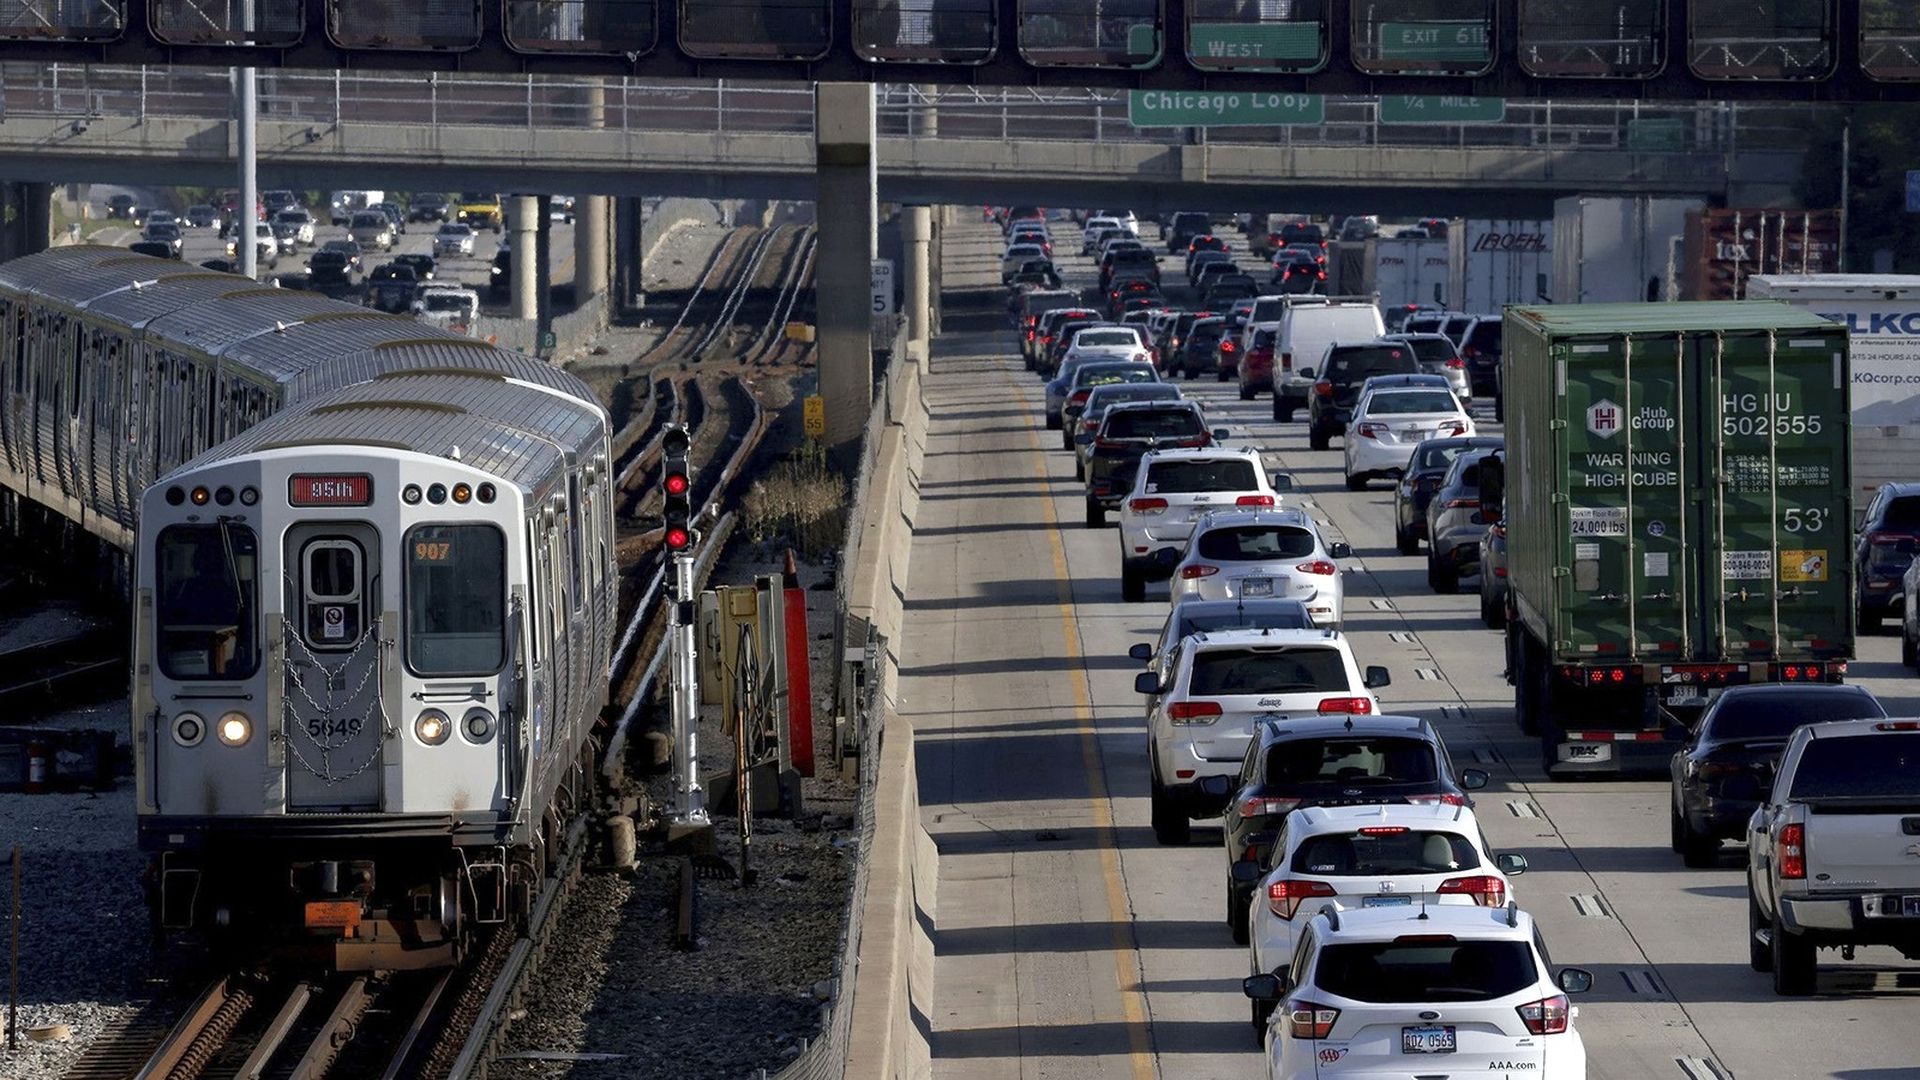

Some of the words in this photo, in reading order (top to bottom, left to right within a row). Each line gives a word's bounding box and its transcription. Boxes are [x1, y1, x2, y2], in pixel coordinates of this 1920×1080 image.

[1402, 29, 1439, 44] EXIT
[1208, 40, 1263, 57] WEST
[1143, 92, 1240, 114] Chicago
[1251, 93, 1310, 111] Loop
[1440, 96, 1480, 107] MILE
[1641, 406, 1668, 419] Hub
[806, 418, 822, 429] 55
[1632, 416, 1675, 431] Group
[1585, 473, 1625, 487] HIGH
[1632, 472, 1677, 486] CUBE
[312, 481, 352, 498] 95th
[1608, 521, 1626, 533] lbs
[415, 542, 450, 560] 907
[308, 718, 361, 737] 5649
[1569, 746, 1599, 757] TRAC
[1489, 1061, 1536, 1070] AAA.com
